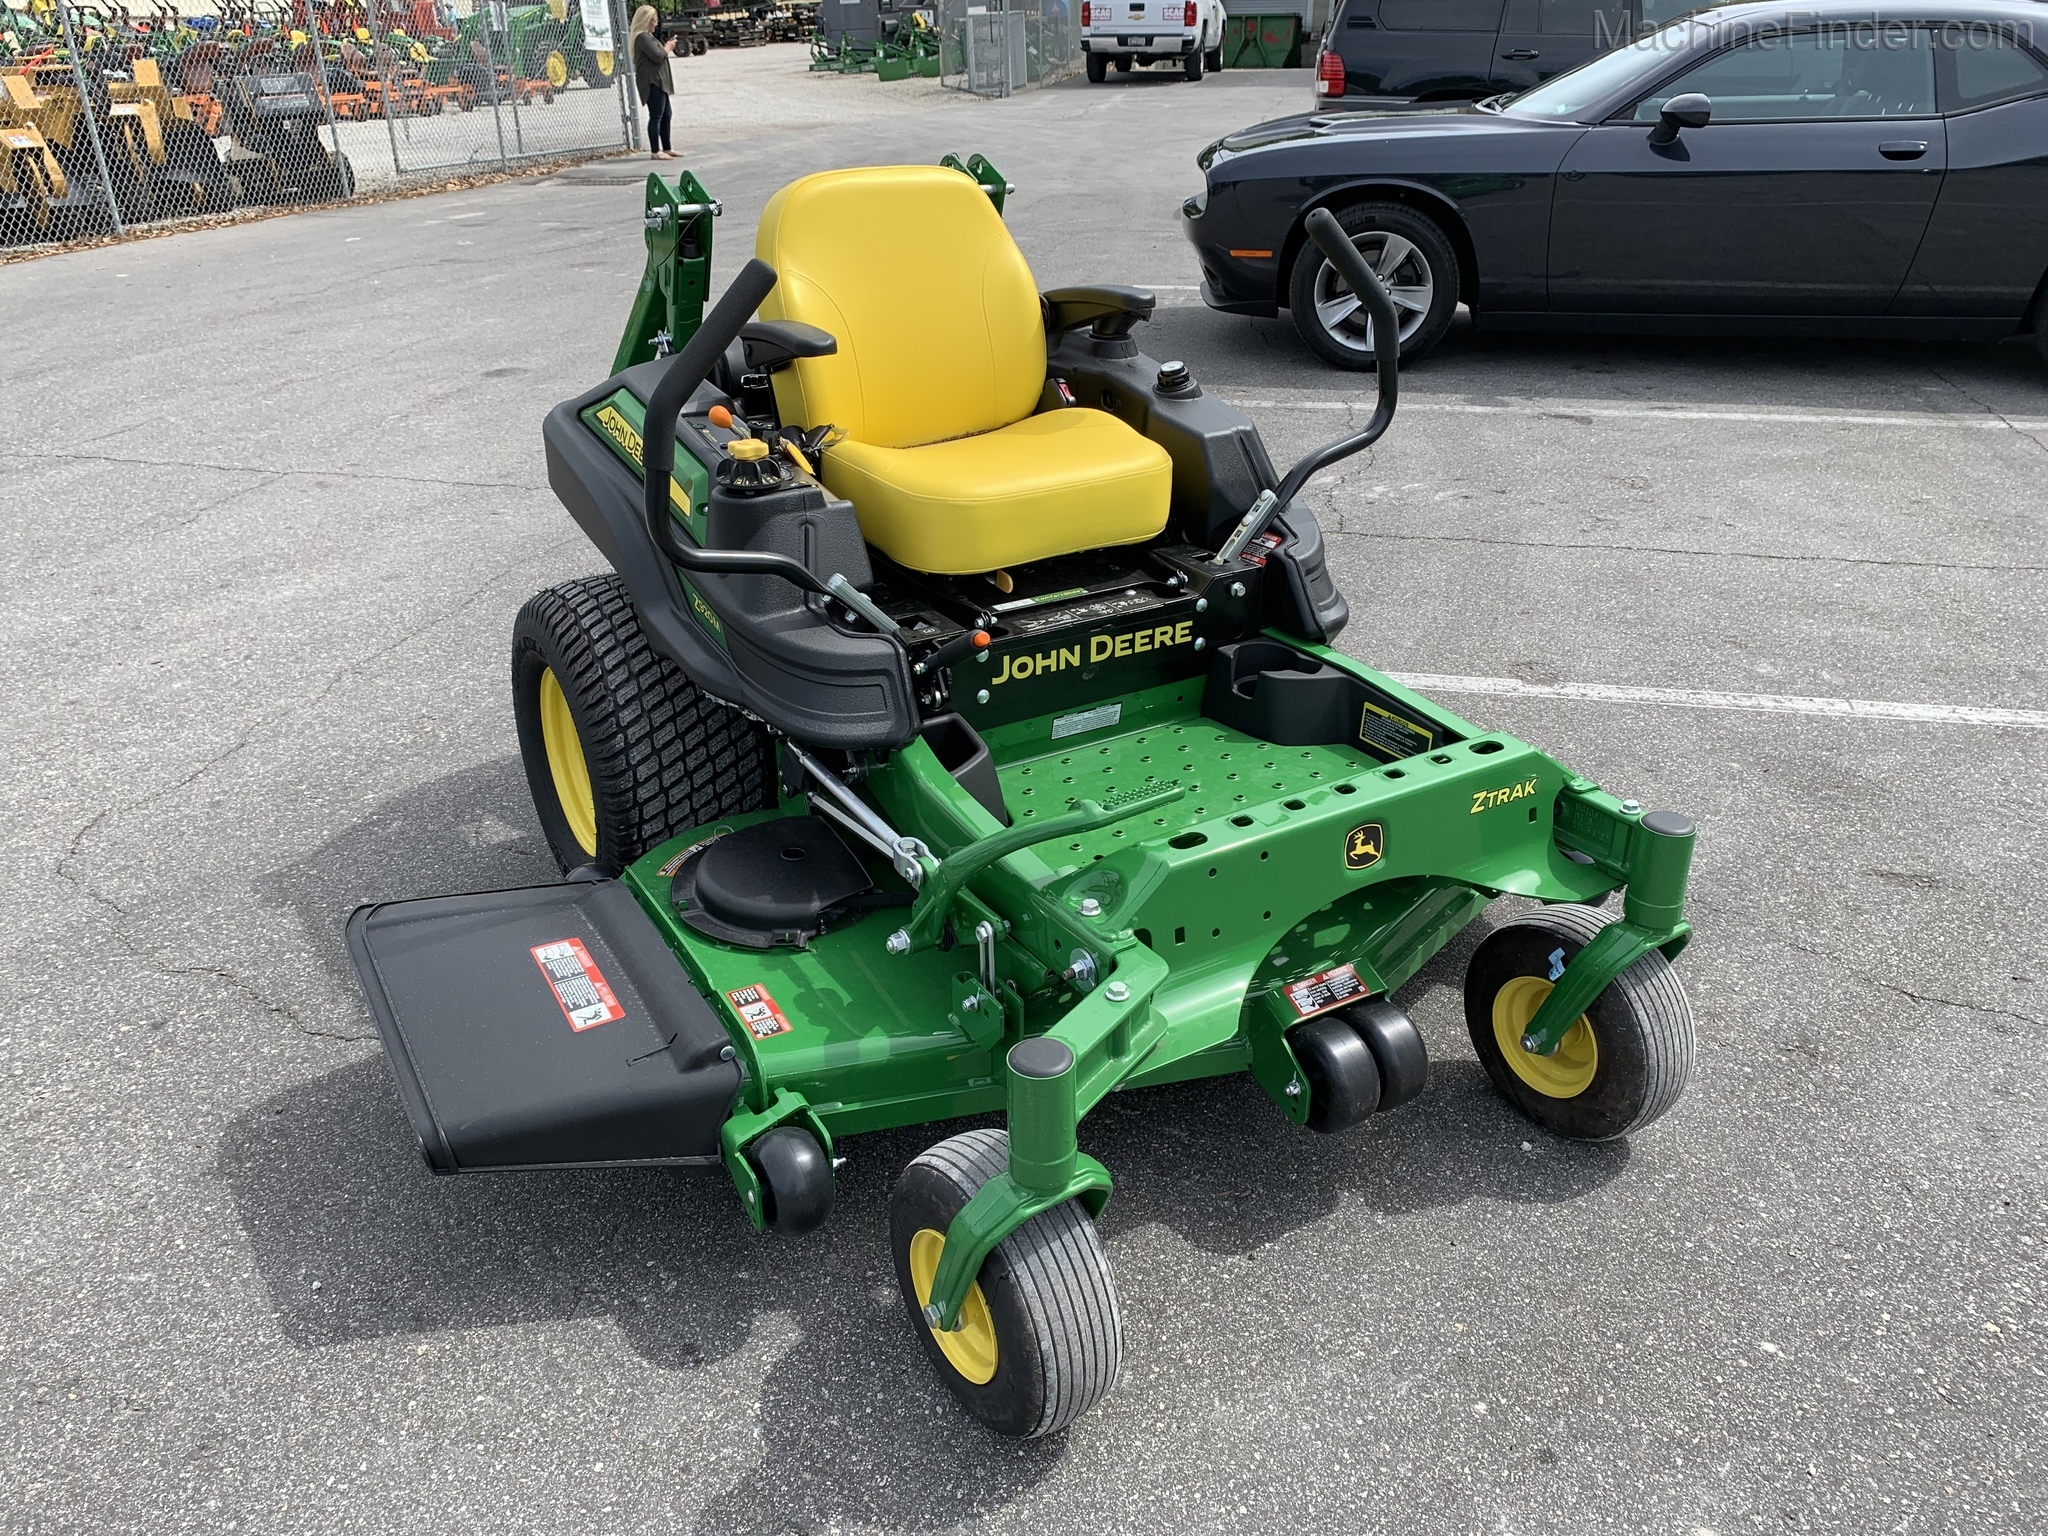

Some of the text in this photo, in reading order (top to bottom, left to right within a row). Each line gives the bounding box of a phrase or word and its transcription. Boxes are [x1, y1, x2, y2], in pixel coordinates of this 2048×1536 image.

[1091, 8, 1111, 17] SCAG
[1164, 8, 1184, 17] SCAG
[604, 410, 627, 443] JOHN
[992, 620, 1193, 685] JOHN DEERE
[1470, 778, 1538, 815] ZTRAK
